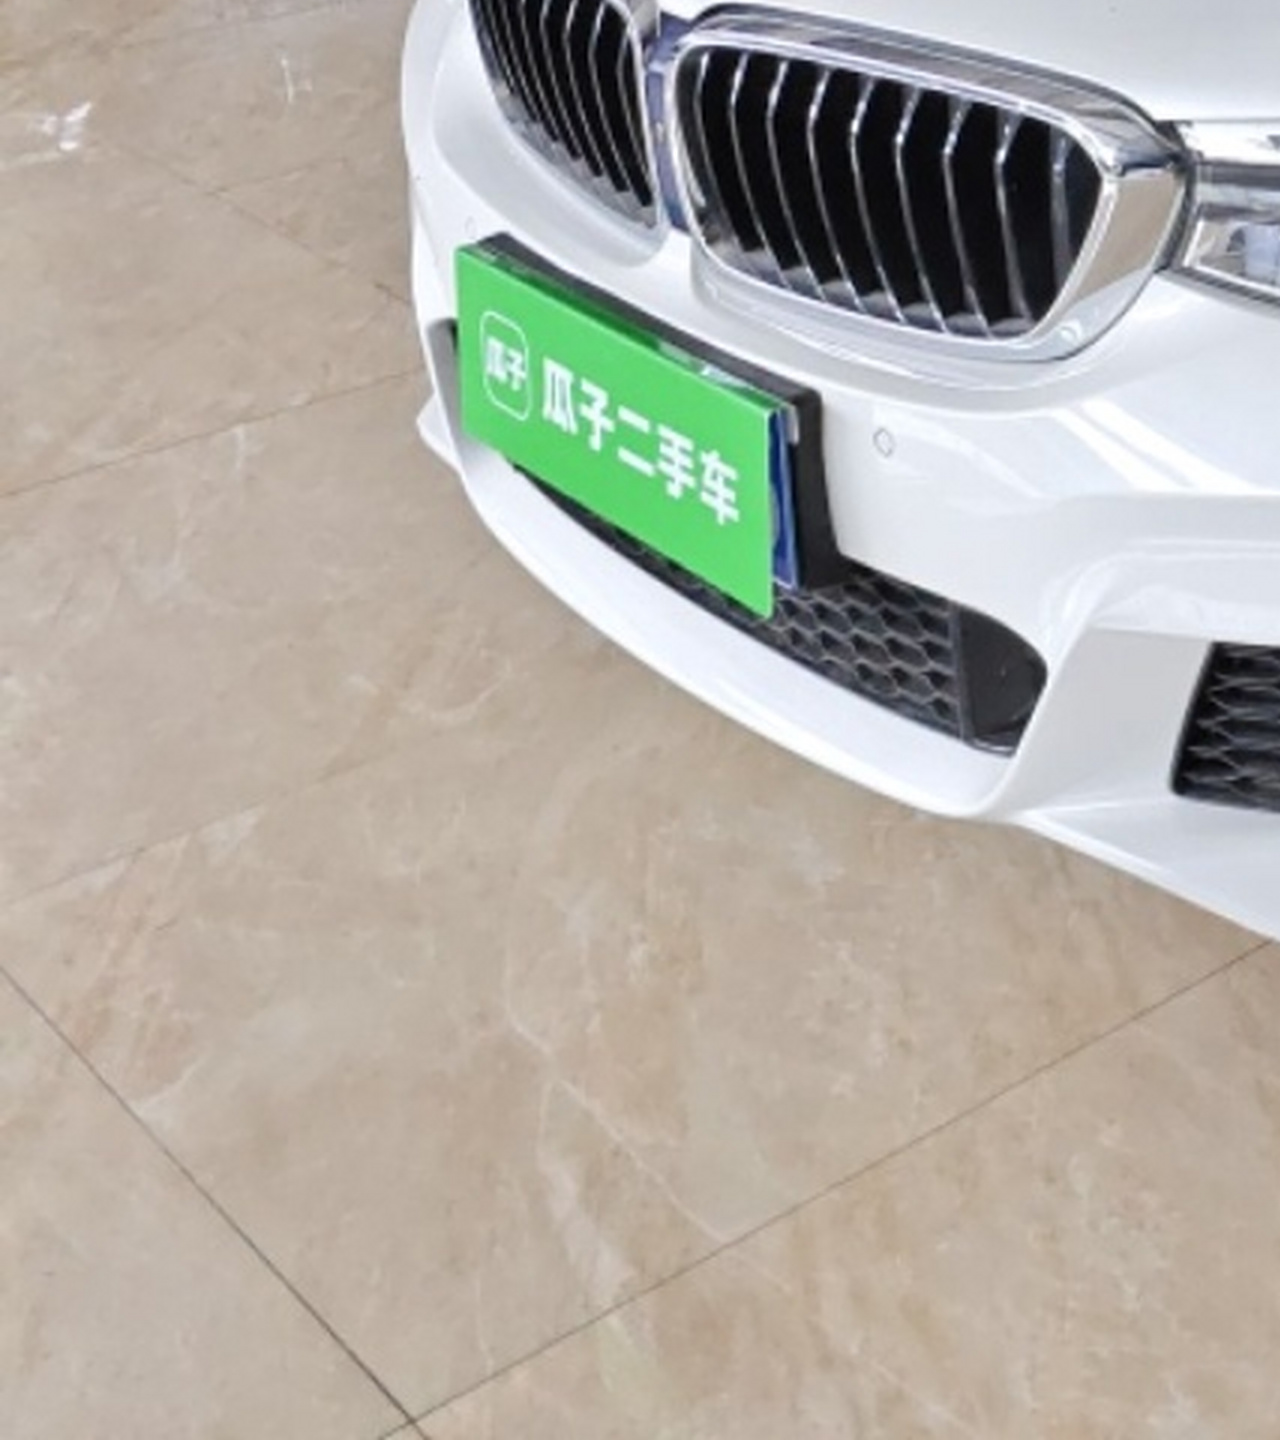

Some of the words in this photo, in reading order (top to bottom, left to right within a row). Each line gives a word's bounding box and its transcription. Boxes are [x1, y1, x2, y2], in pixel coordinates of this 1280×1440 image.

[541, 356, 741, 526] 瓜子二手车
